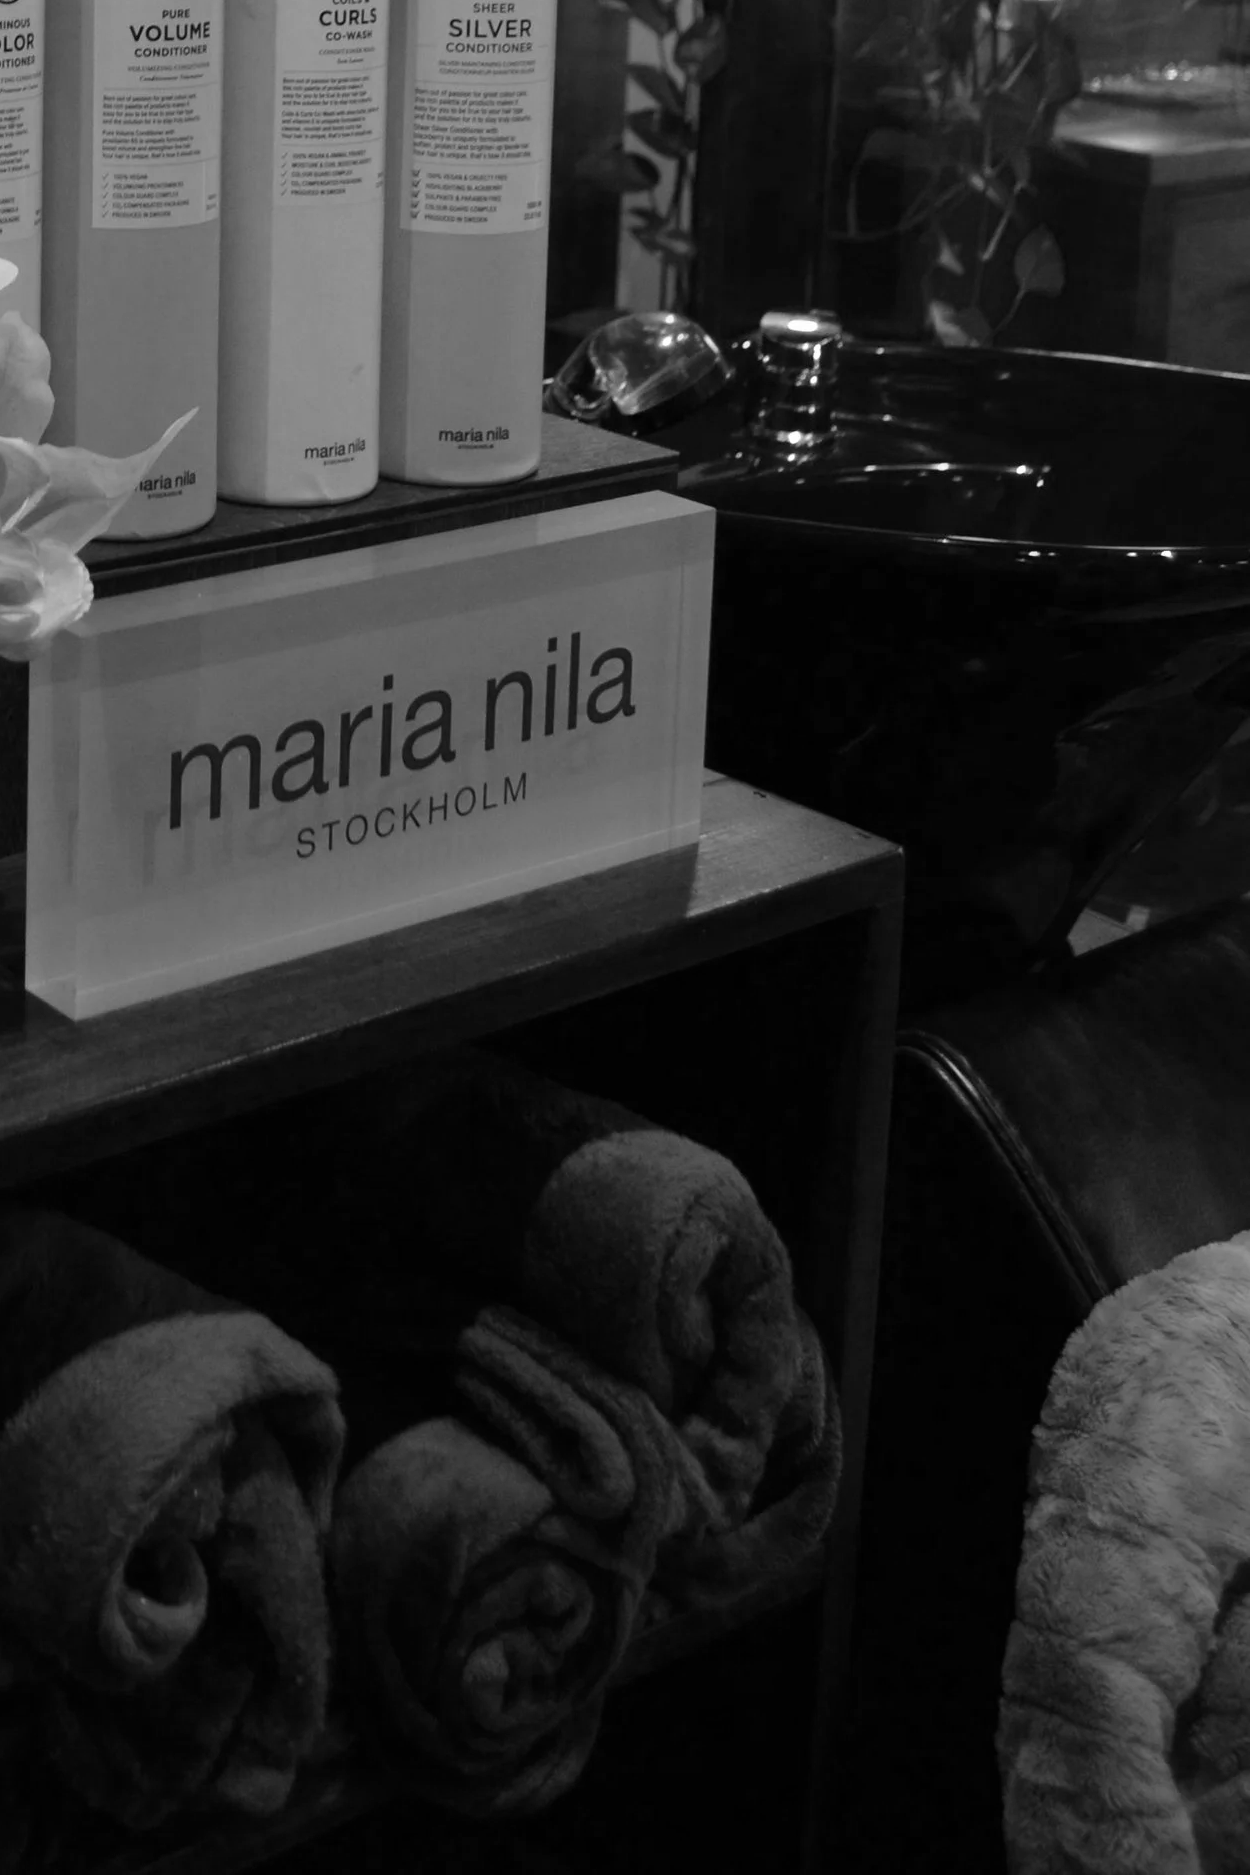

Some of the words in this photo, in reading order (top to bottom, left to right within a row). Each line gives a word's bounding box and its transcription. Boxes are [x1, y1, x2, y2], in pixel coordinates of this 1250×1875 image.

[162, 8, 190, 19] PURE
[319, 7, 377, 26] CURLS
[473, 3, 515, 14] SHEER
[129, 21, 210, 42] VOLUME
[325, 30, 373, 41] CO-WASH
[449, 19, 532, 38] SILVER
[134, 44, 207, 58] CONDITIONER
[446, 42, 533, 53] CONDITIONER
[439, 428, 483, 442] maria
[486, 426, 509, 441] nila
[304, 442, 345, 459] maria
[348, 437, 366, 454] nila
[135, 475, 172, 492] aria
[175, 469, 196, 487] nila
[169, 674, 456, 830] maria
[484, 631, 636, 751] nila
[296, 773, 528, 859] STOCKHOLM
